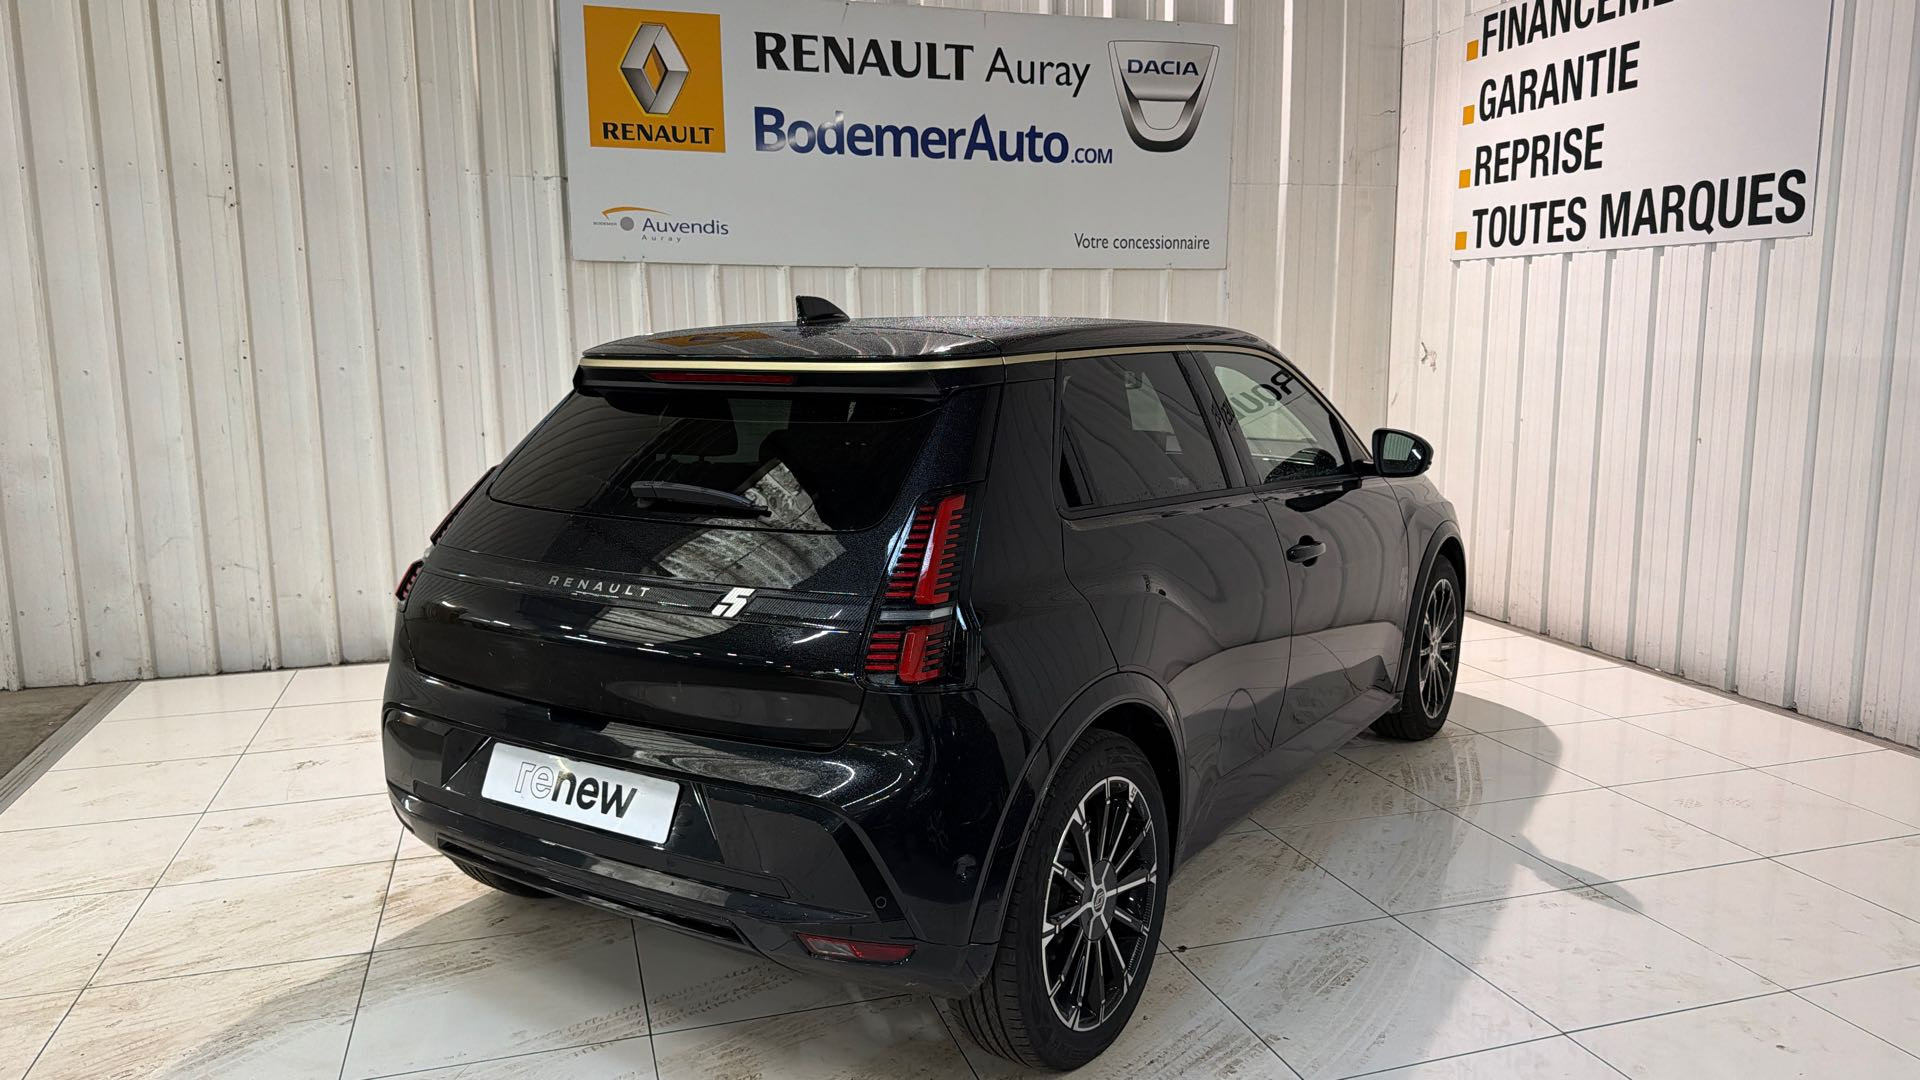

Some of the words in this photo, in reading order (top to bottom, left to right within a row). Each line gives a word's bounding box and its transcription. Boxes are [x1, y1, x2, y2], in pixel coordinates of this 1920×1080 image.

[754, 32, 974, 81] RENAULT
[985, 47, 1091, 98] Auray
[1127, 59, 1199, 76] DACIA
[1478, 40, 1641, 122] GARANTIE
[602, 122, 714, 145] RENAULT
[1474, 123, 1605, 187] REPRISE
[1473, 197, 1587, 249] TOUTES
[1599, 169, 1807, 239] MARQUES
[641, 234, 682, 243] Auray
[642, 217, 729, 236] Auvendis
[1074, 232, 1109, 249] Votre
[1112, 234, 1210, 250] concessionnaire
[548, 575, 650, 597] RENAULT
[711, 587, 756, 618] 5
[515, 761, 638, 818] renew
